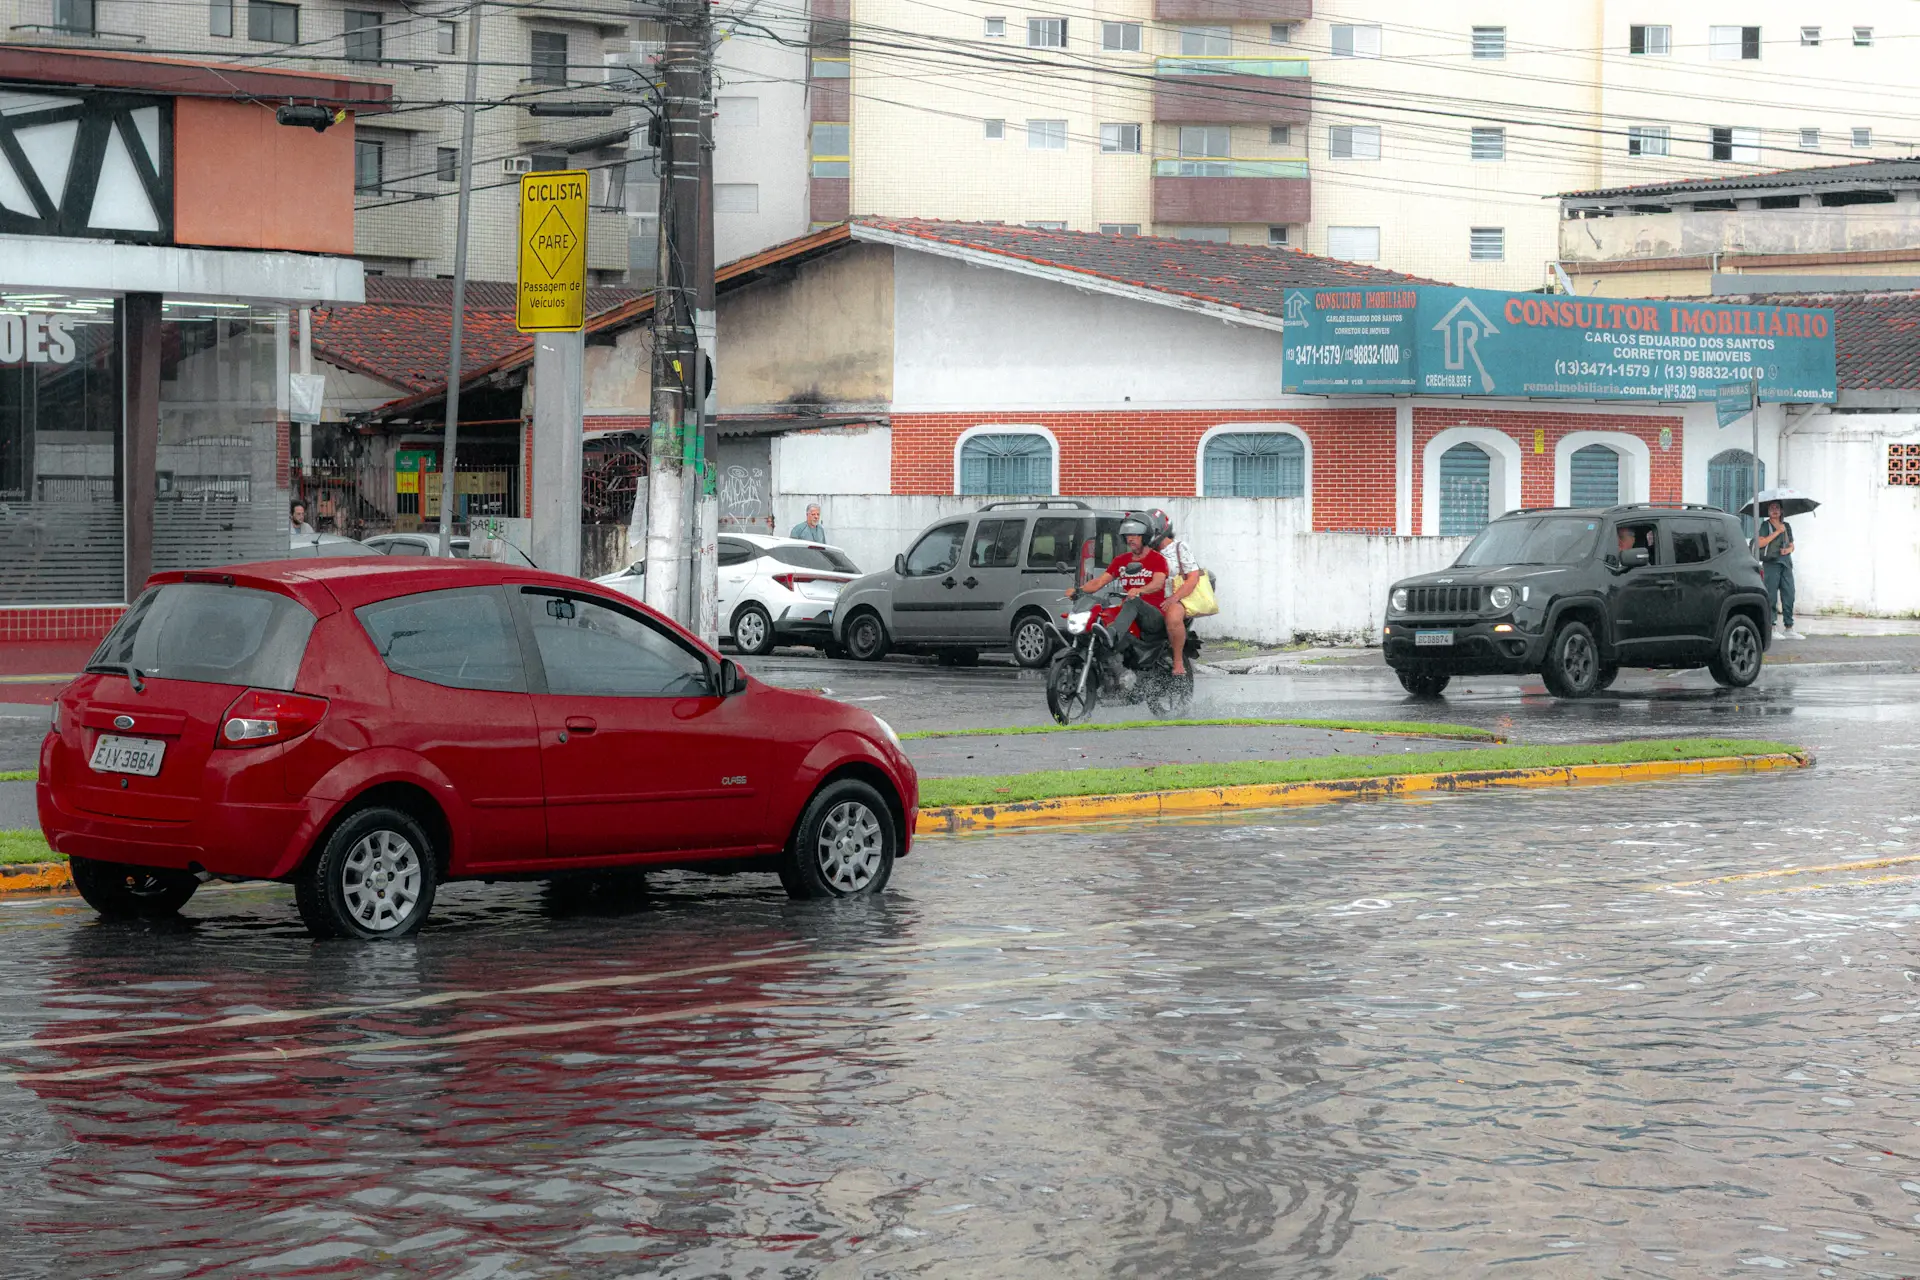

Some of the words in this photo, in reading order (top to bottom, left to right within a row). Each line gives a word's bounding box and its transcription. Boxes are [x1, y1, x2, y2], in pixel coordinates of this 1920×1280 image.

[527, 183, 583, 202] CICLISTA
[538, 234, 569, 249] PARE
[523, 282, 567, 295] Passagem
[569, 281, 580, 291] de
[529, 296, 565, 308] Veículos
[1315, 292, 1362, 310] CONSULTOR
[1365, 289, 1417, 309] IMOBILIÁRIO
[1325, 315, 1346, 323] CARLOS
[1382, 314, 1403, 322] SANTOS
[1504, 298, 1660, 332] CONSULTOR
[1670, 306, 1828, 339] IMOBILIÁRIO
[1334, 327, 1361, 335] CORRETOR
[1361, 327, 1369, 335] DE
[1369, 327, 1390, 335] IMOVEIS
[1584, 332, 1636, 345] CARLOS
[1638, 334, 1697, 348] EDUARDO
[1699, 336, 1724, 349] DOS
[1726, 337, 1775, 350] SANTOS
[1613, 347, 1681, 361] CORRETOR
[1683, 350, 1700, 361] DE
[1702, 351, 1752, 362] IMOVEIS
